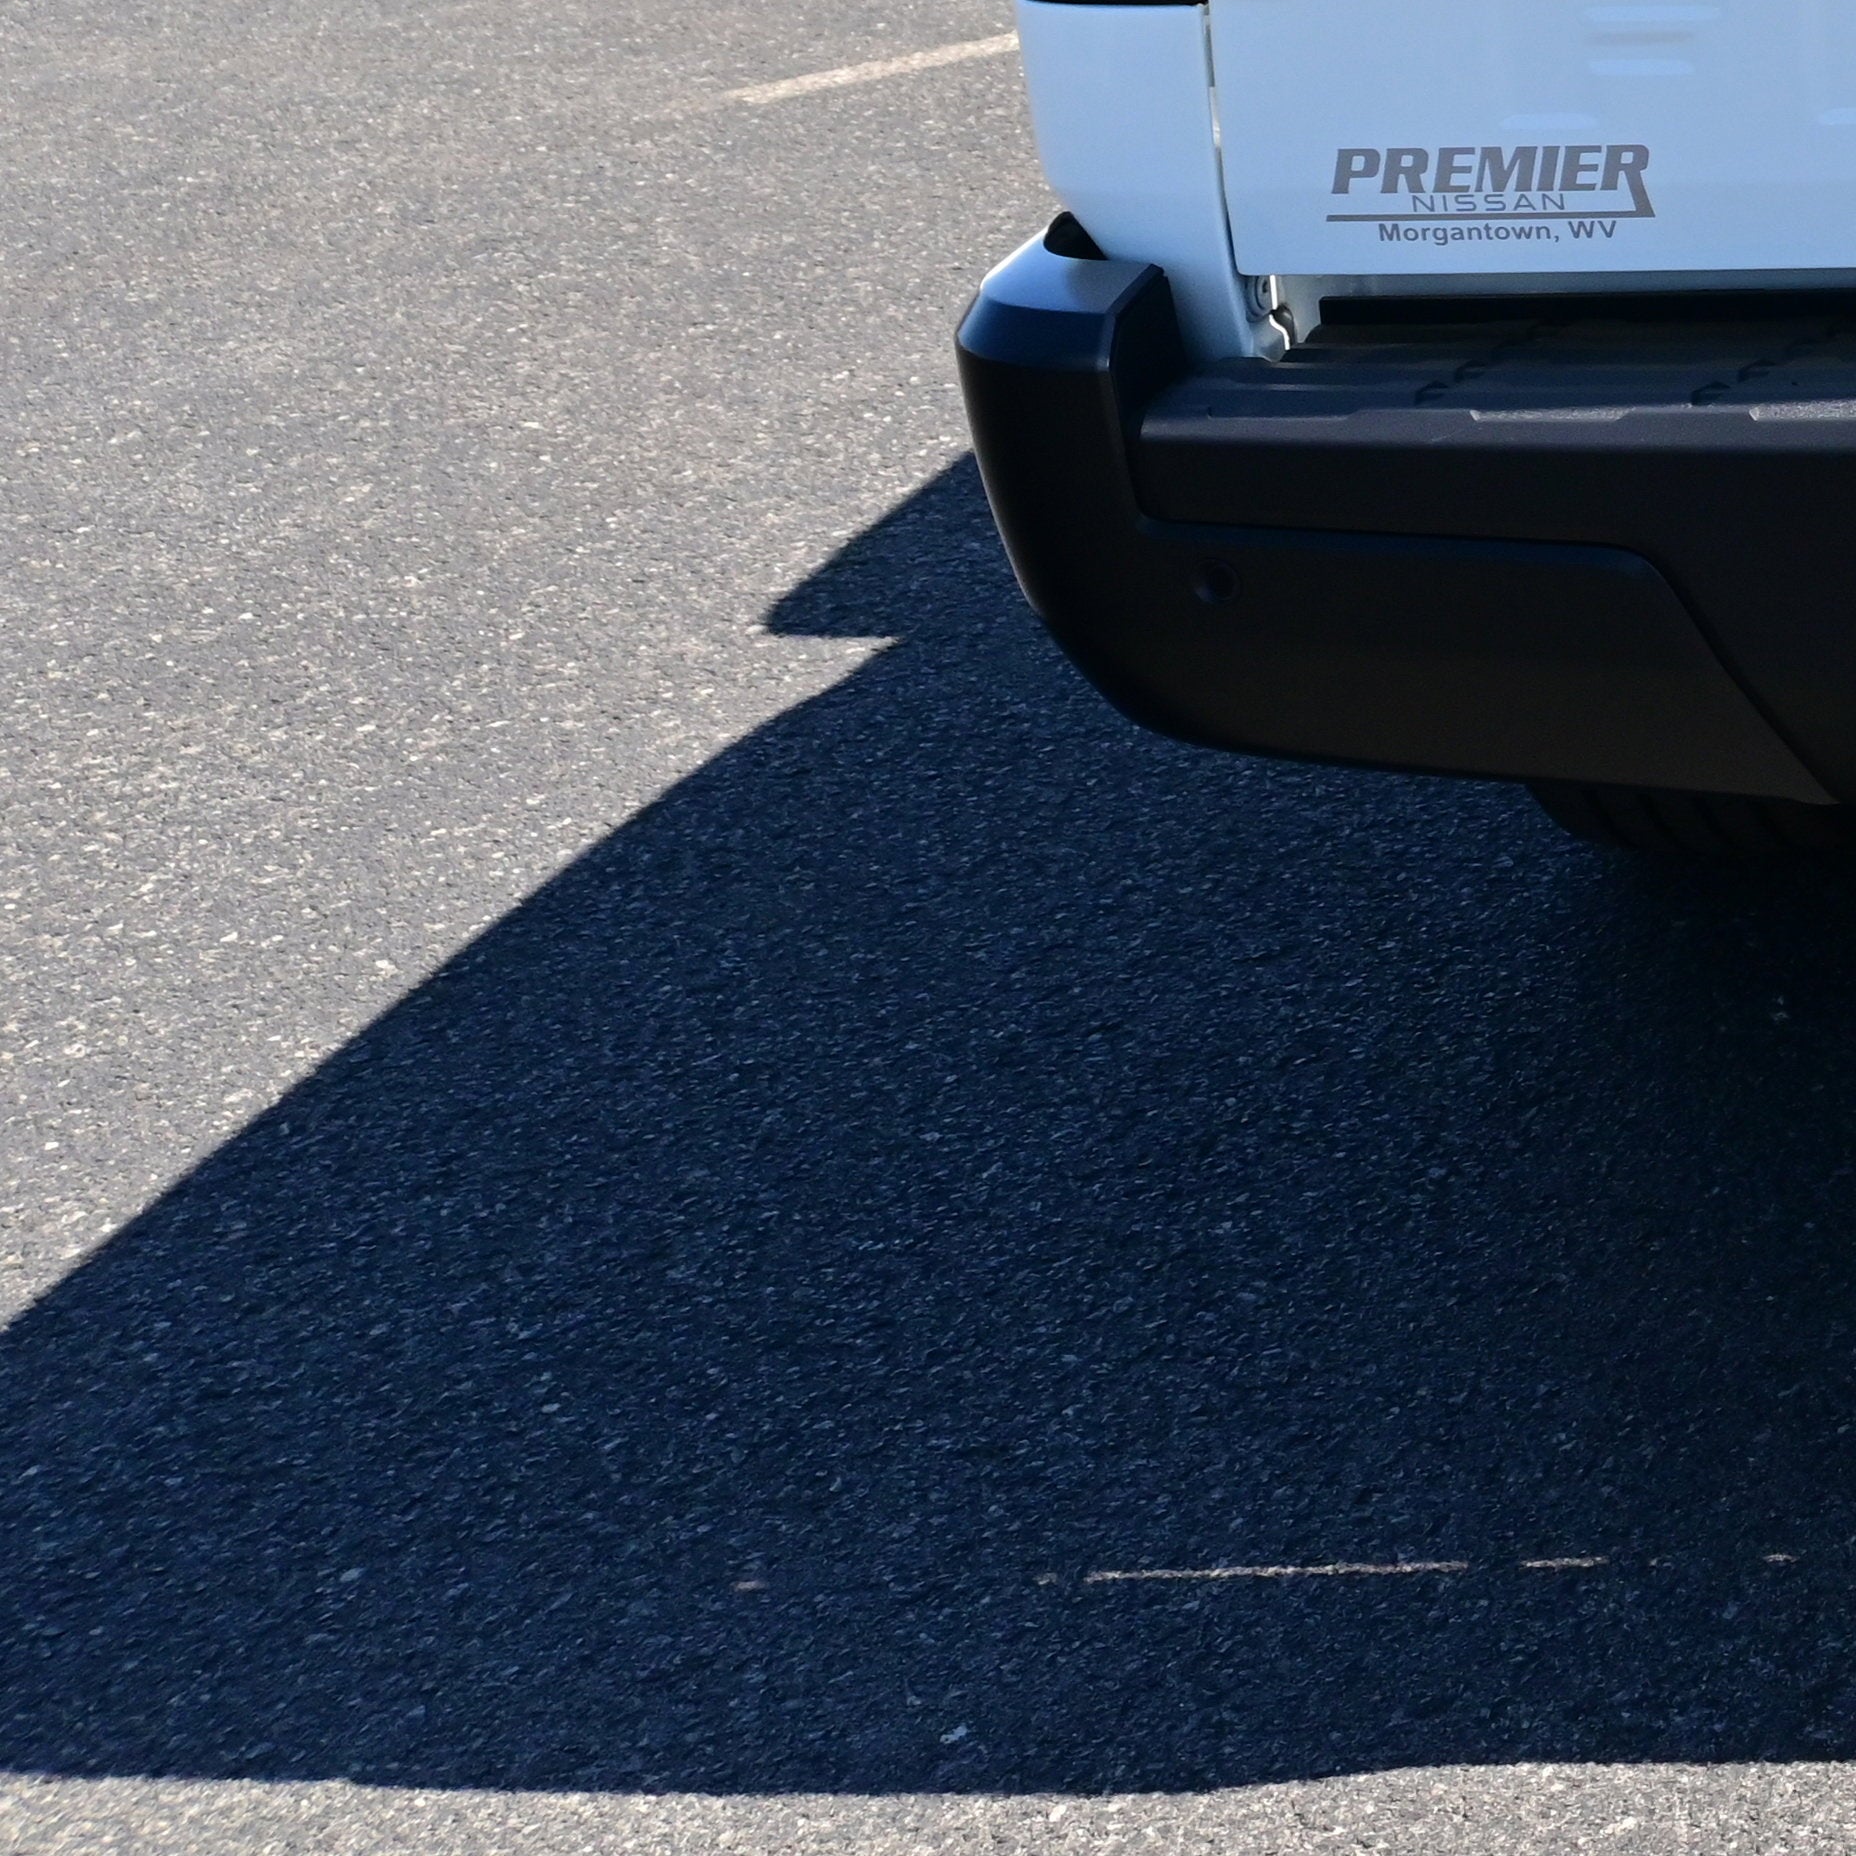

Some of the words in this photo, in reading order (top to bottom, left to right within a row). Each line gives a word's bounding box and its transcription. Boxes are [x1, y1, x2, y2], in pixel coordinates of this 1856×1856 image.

[1330, 144, 1656, 218] PREMIER
[1411, 192, 1567, 213] NISSAN
[1378, 221, 1561, 246] Morgantown,
[1568, 220, 1617, 240] WV
